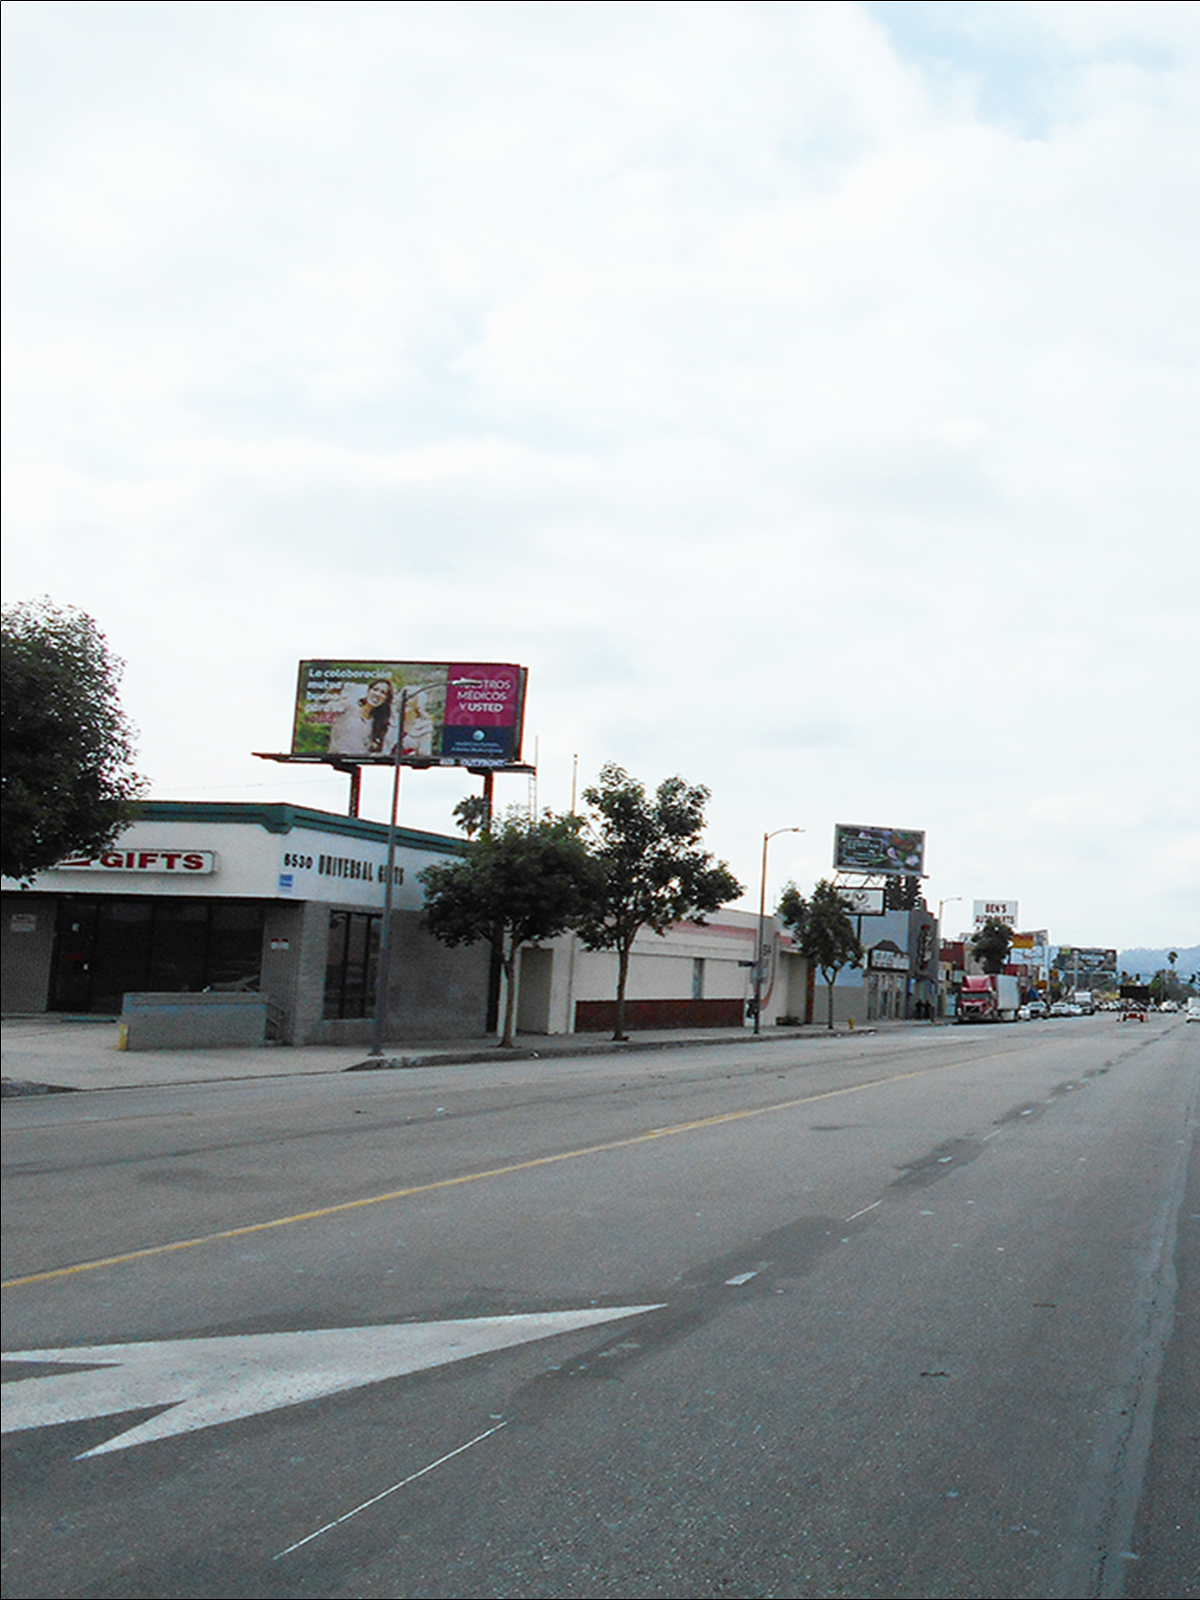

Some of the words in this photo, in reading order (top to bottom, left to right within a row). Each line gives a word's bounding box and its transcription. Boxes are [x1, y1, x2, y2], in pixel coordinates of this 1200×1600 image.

[457, 690, 507, 700] MÉDICOS
[459, 702, 466, 711] Y
[468, 702, 504, 712] USTED
[101, 852, 204, 870] GIFTS
[284, 853, 313, 869] 6530
[318, 854, 373, 882] UNIVERSAL
[985, 903, 1007, 913] BEN'S
